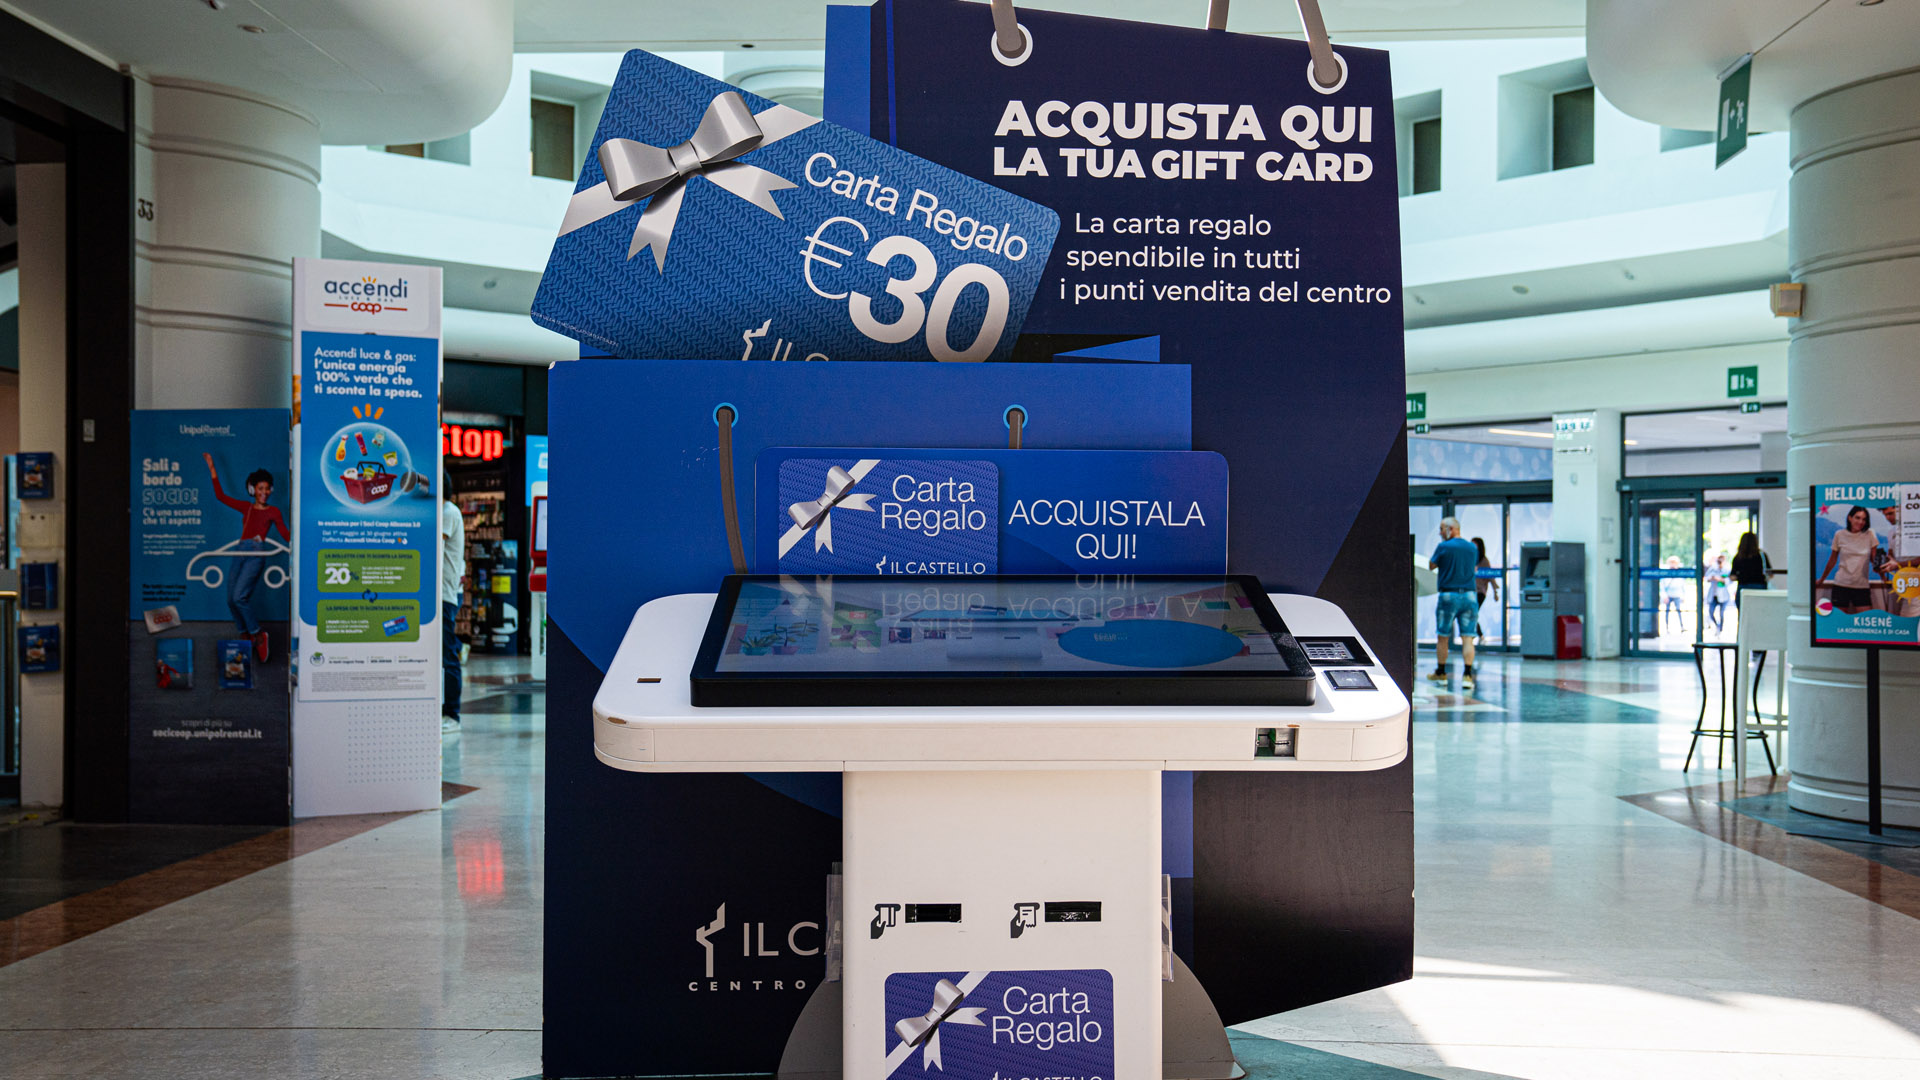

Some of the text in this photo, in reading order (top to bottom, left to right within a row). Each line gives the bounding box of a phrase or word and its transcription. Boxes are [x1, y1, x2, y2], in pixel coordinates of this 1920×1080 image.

[995, 101, 1373, 150] ACQUISTA QUI
[993, 147, 1373, 182] LA TUA GIFT CARD
[138, 198, 153, 221] 33
[804, 152, 1028, 262] Carta Regalo
[1076, 212, 1272, 240] La carta regalo
[1067, 246, 1300, 271] spendibile in tutti
[324, 278, 408, 298] accendi
[799, 216, 1010, 363] €30
[1060, 277, 1391, 304] i punti vendita del centro
[351, 302, 382, 315] coop
[314, 347, 416, 364] Accendi luce & gas:
[314, 358, 406, 375] l'unica energia
[315, 371, 413, 385] 100% verde che
[314, 383, 422, 399] ti sconta la spesa.
[143, 458, 180, 471] Sali a
[143, 473, 182, 485] bordo
[892, 475, 975, 504] Carta
[143, 488, 199, 505] SOCIO!
[1825, 486, 1896, 501] HELLO SUM
[143, 517, 201, 526] che ti aspetta
[173, 508, 202, 516] sconto
[882, 503, 986, 537] Regalo
[1008, 500, 1206, 527] ACQUISTALA
[1076, 534, 1136, 560] QUI!
[325, 567, 359, 585] 20%
[891, 561, 986, 575] IL CASTELLO
[744, 921, 827, 957] IL C
[688, 980, 806, 992] CENTRO
[1003, 986, 1091, 1016] Carta
[992, 1015, 1102, 1050] Regalo
